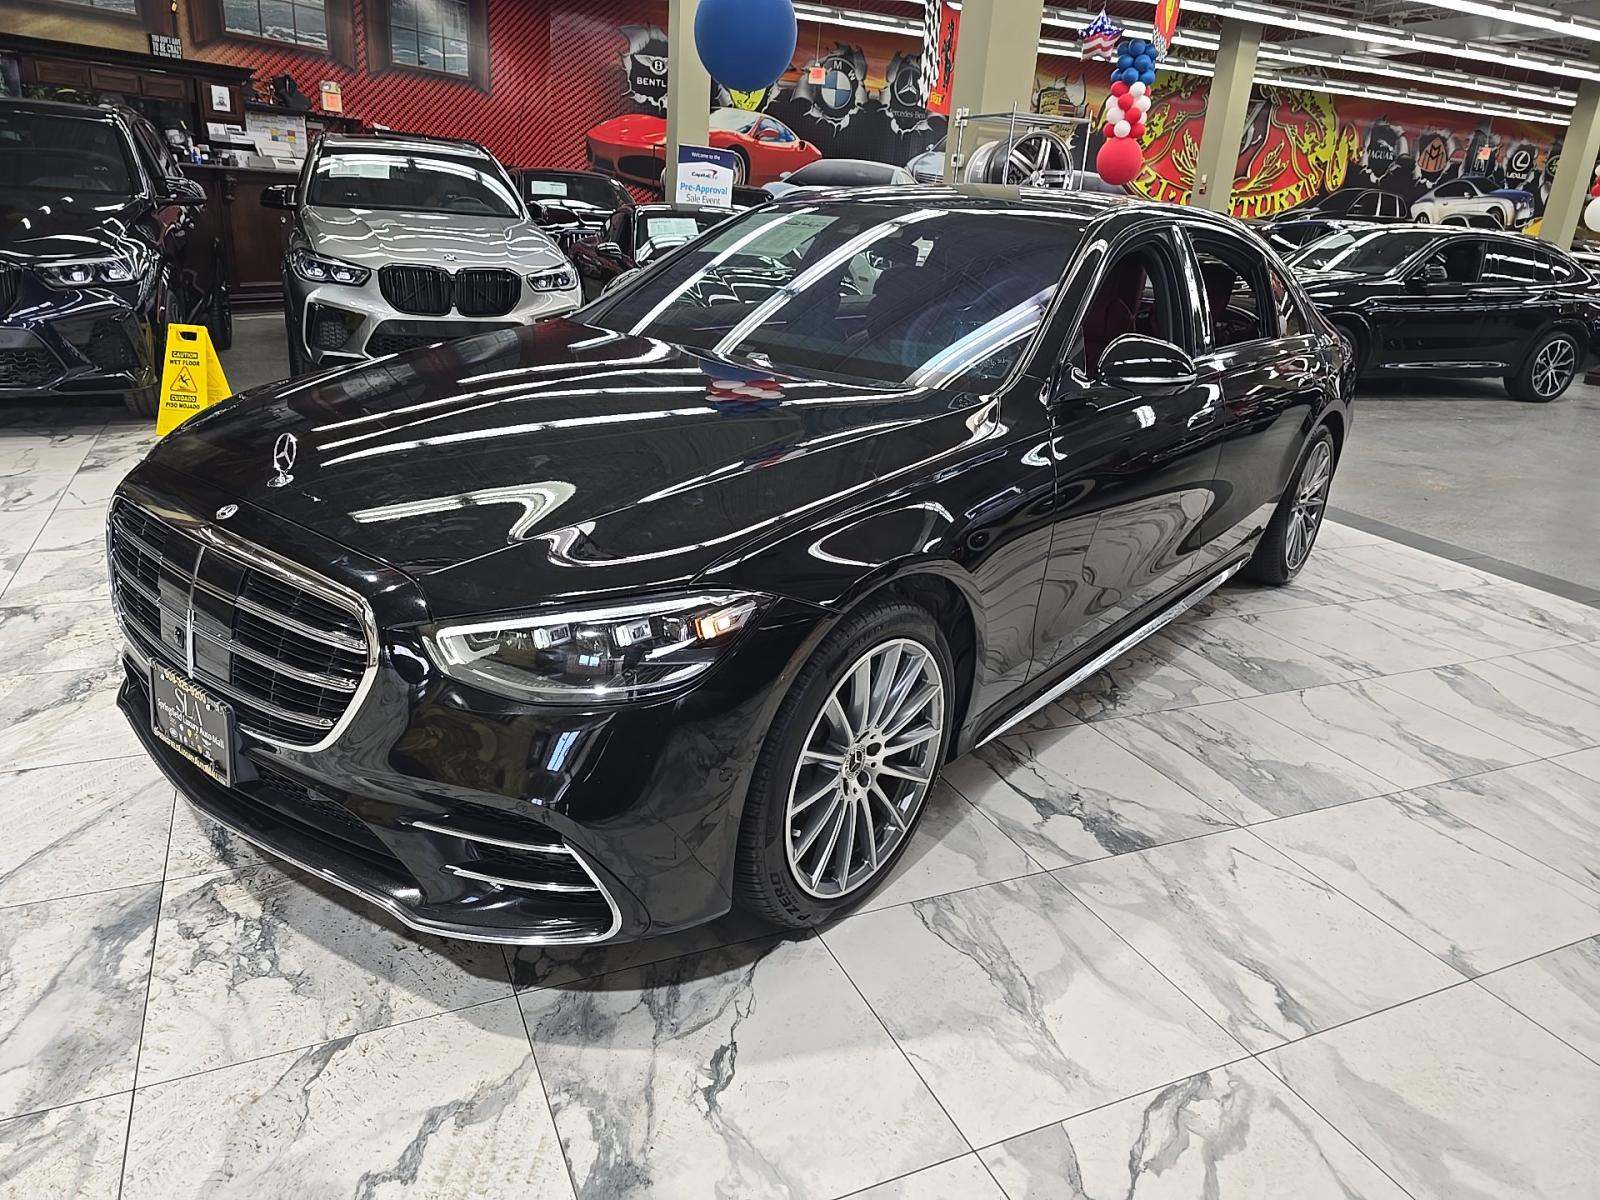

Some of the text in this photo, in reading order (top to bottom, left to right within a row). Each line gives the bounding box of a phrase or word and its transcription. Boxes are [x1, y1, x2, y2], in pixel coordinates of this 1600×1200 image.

[636, 76, 667, 88] BENTL
[680, 181, 728, 195] Pre-Approval
[686, 193, 720, 205] Sale Event
[172, 351, 198, 359] CAUTION
[170, 394, 197, 402] CUIDADO
